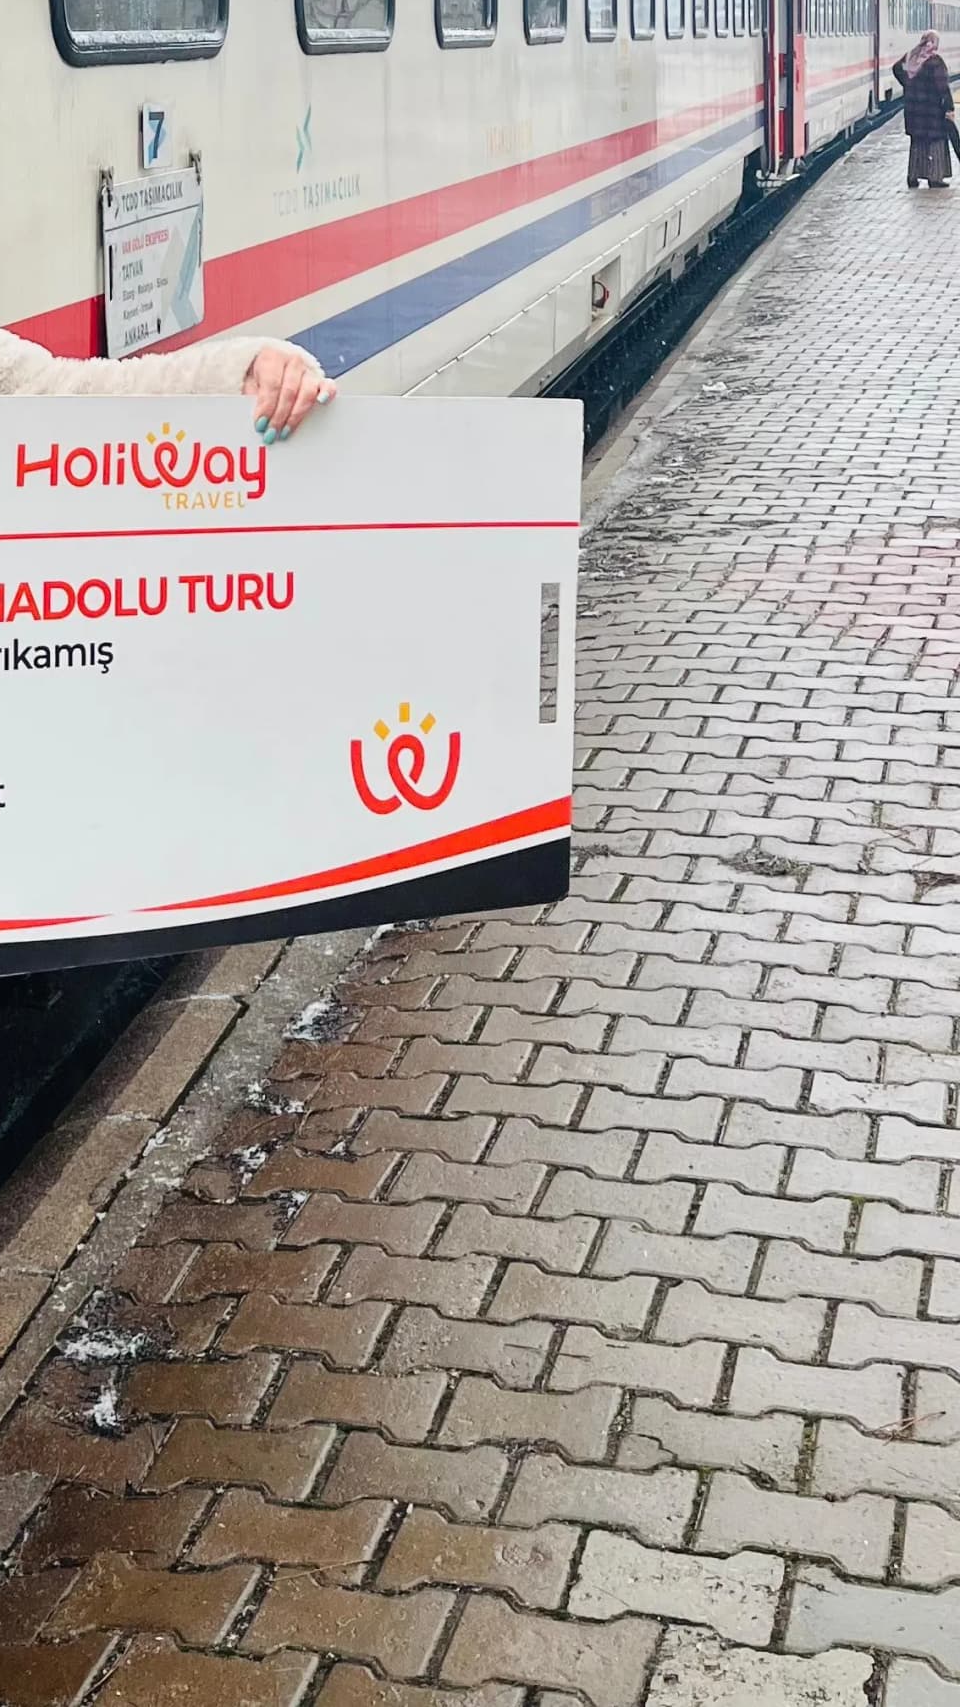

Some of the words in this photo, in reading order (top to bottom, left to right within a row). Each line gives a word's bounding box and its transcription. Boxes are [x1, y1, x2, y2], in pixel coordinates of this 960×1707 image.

[148, 111, 165, 159] 7
[121, 191, 138, 212] TCDD
[161, 490, 246, 511] TRAVEL
[178, 570, 296, 614] TURU
